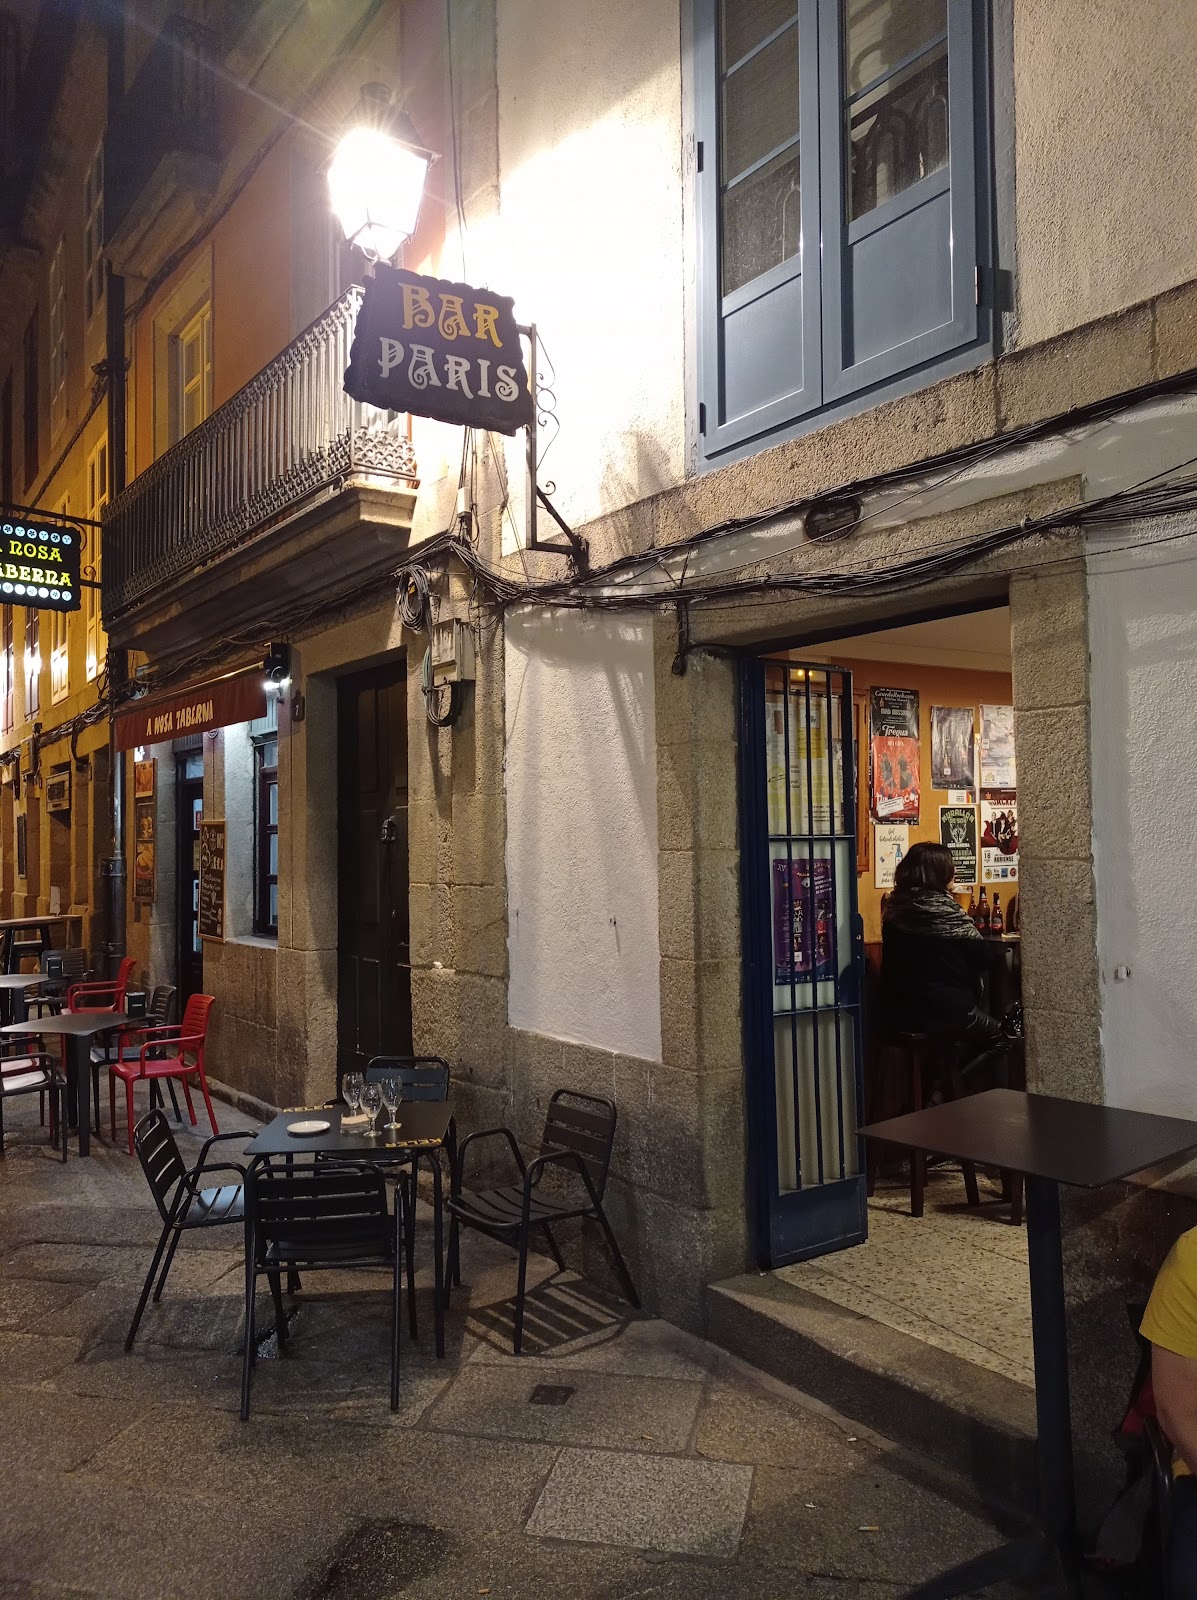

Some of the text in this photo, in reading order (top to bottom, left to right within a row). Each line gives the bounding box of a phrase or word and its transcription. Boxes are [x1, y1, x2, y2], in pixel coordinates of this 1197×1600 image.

[398, 282, 503, 348] BAR
[377, 336, 519, 402] PARIS
[9, 540, 63, 562] NOSA
[146, 700, 214, 736] A NOSA TABERNA
